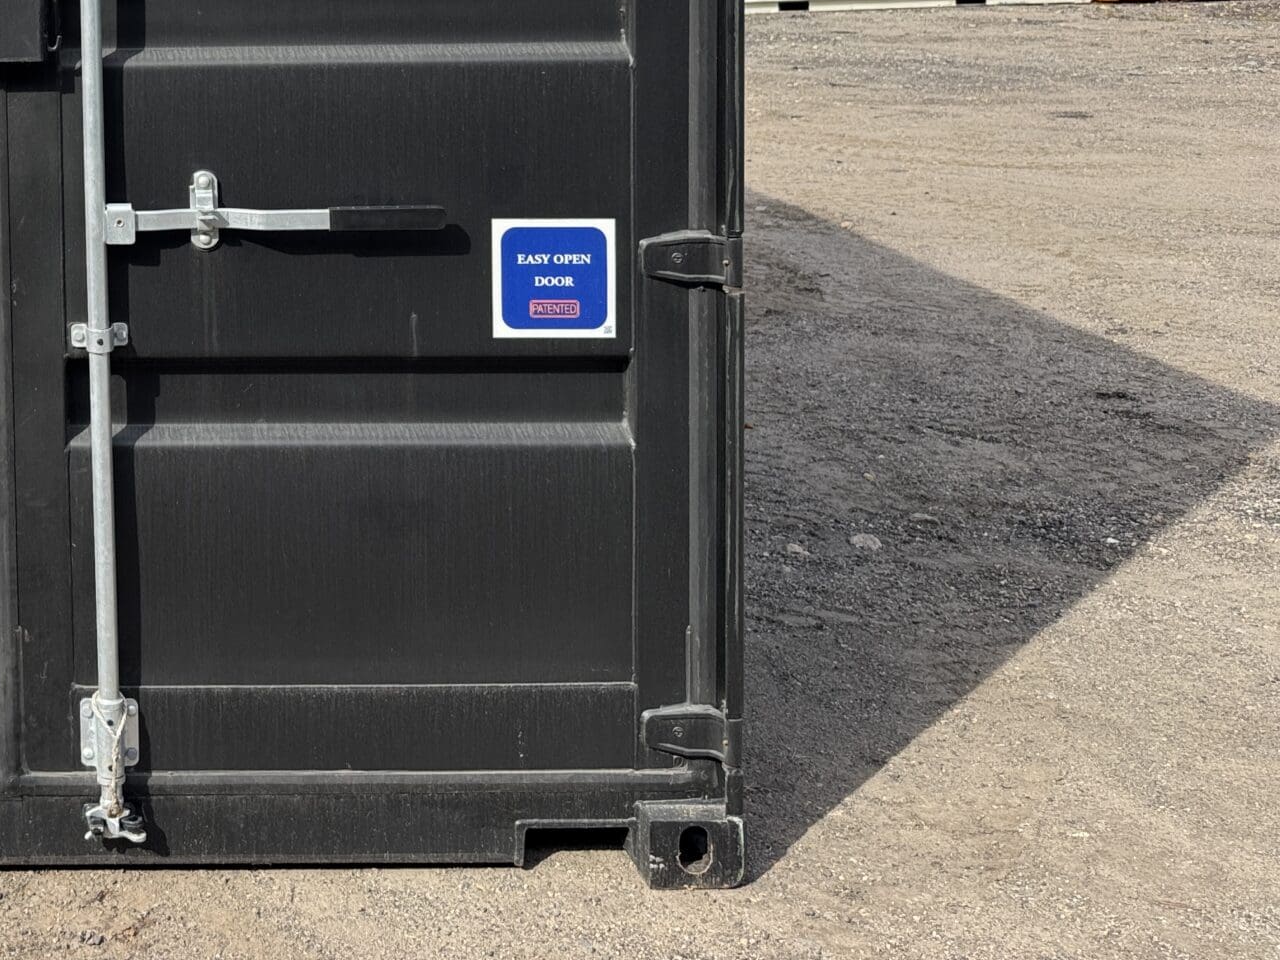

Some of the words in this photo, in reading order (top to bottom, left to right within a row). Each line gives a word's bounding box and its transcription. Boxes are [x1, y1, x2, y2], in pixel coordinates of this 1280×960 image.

[516, 253, 552, 265] EASY
[553, 253, 592, 265] OPEN
[534, 275, 575, 287] DOOR
[531, 302, 578, 315] PATENTED
